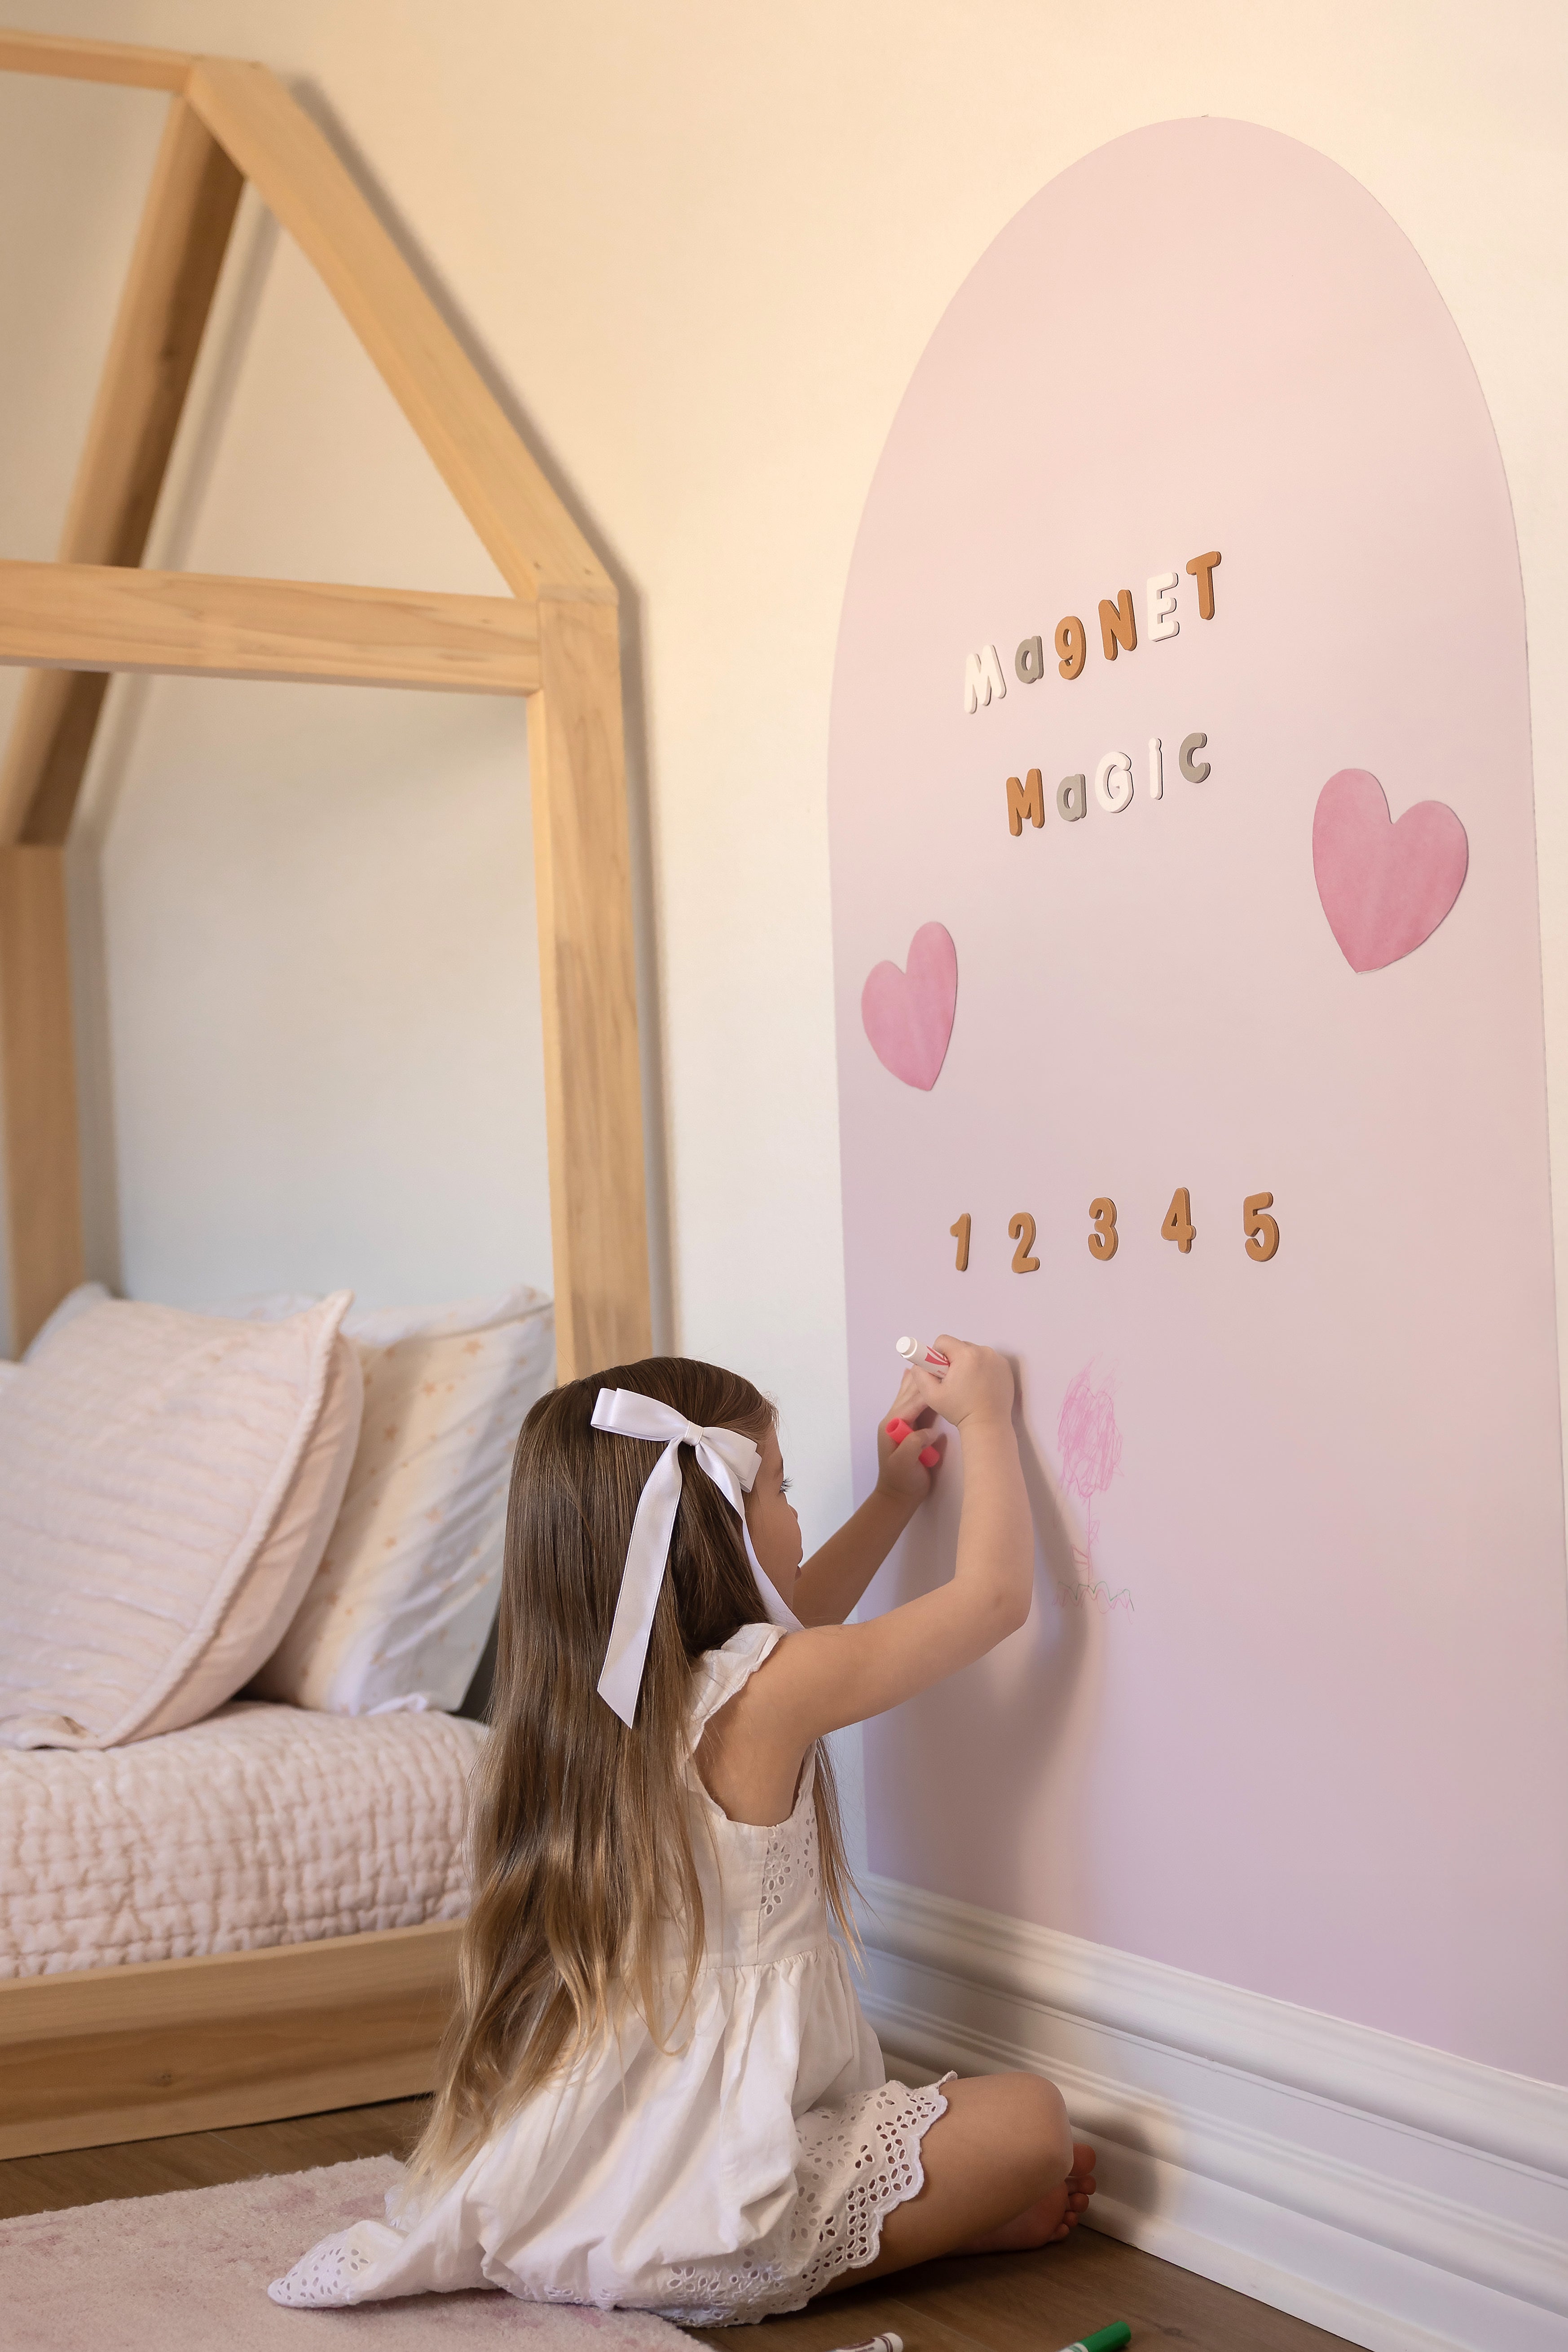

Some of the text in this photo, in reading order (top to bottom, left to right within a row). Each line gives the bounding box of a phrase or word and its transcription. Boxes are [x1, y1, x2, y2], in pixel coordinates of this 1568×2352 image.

[950, 1187, 1279, 1273] 1 2 3 4 5
